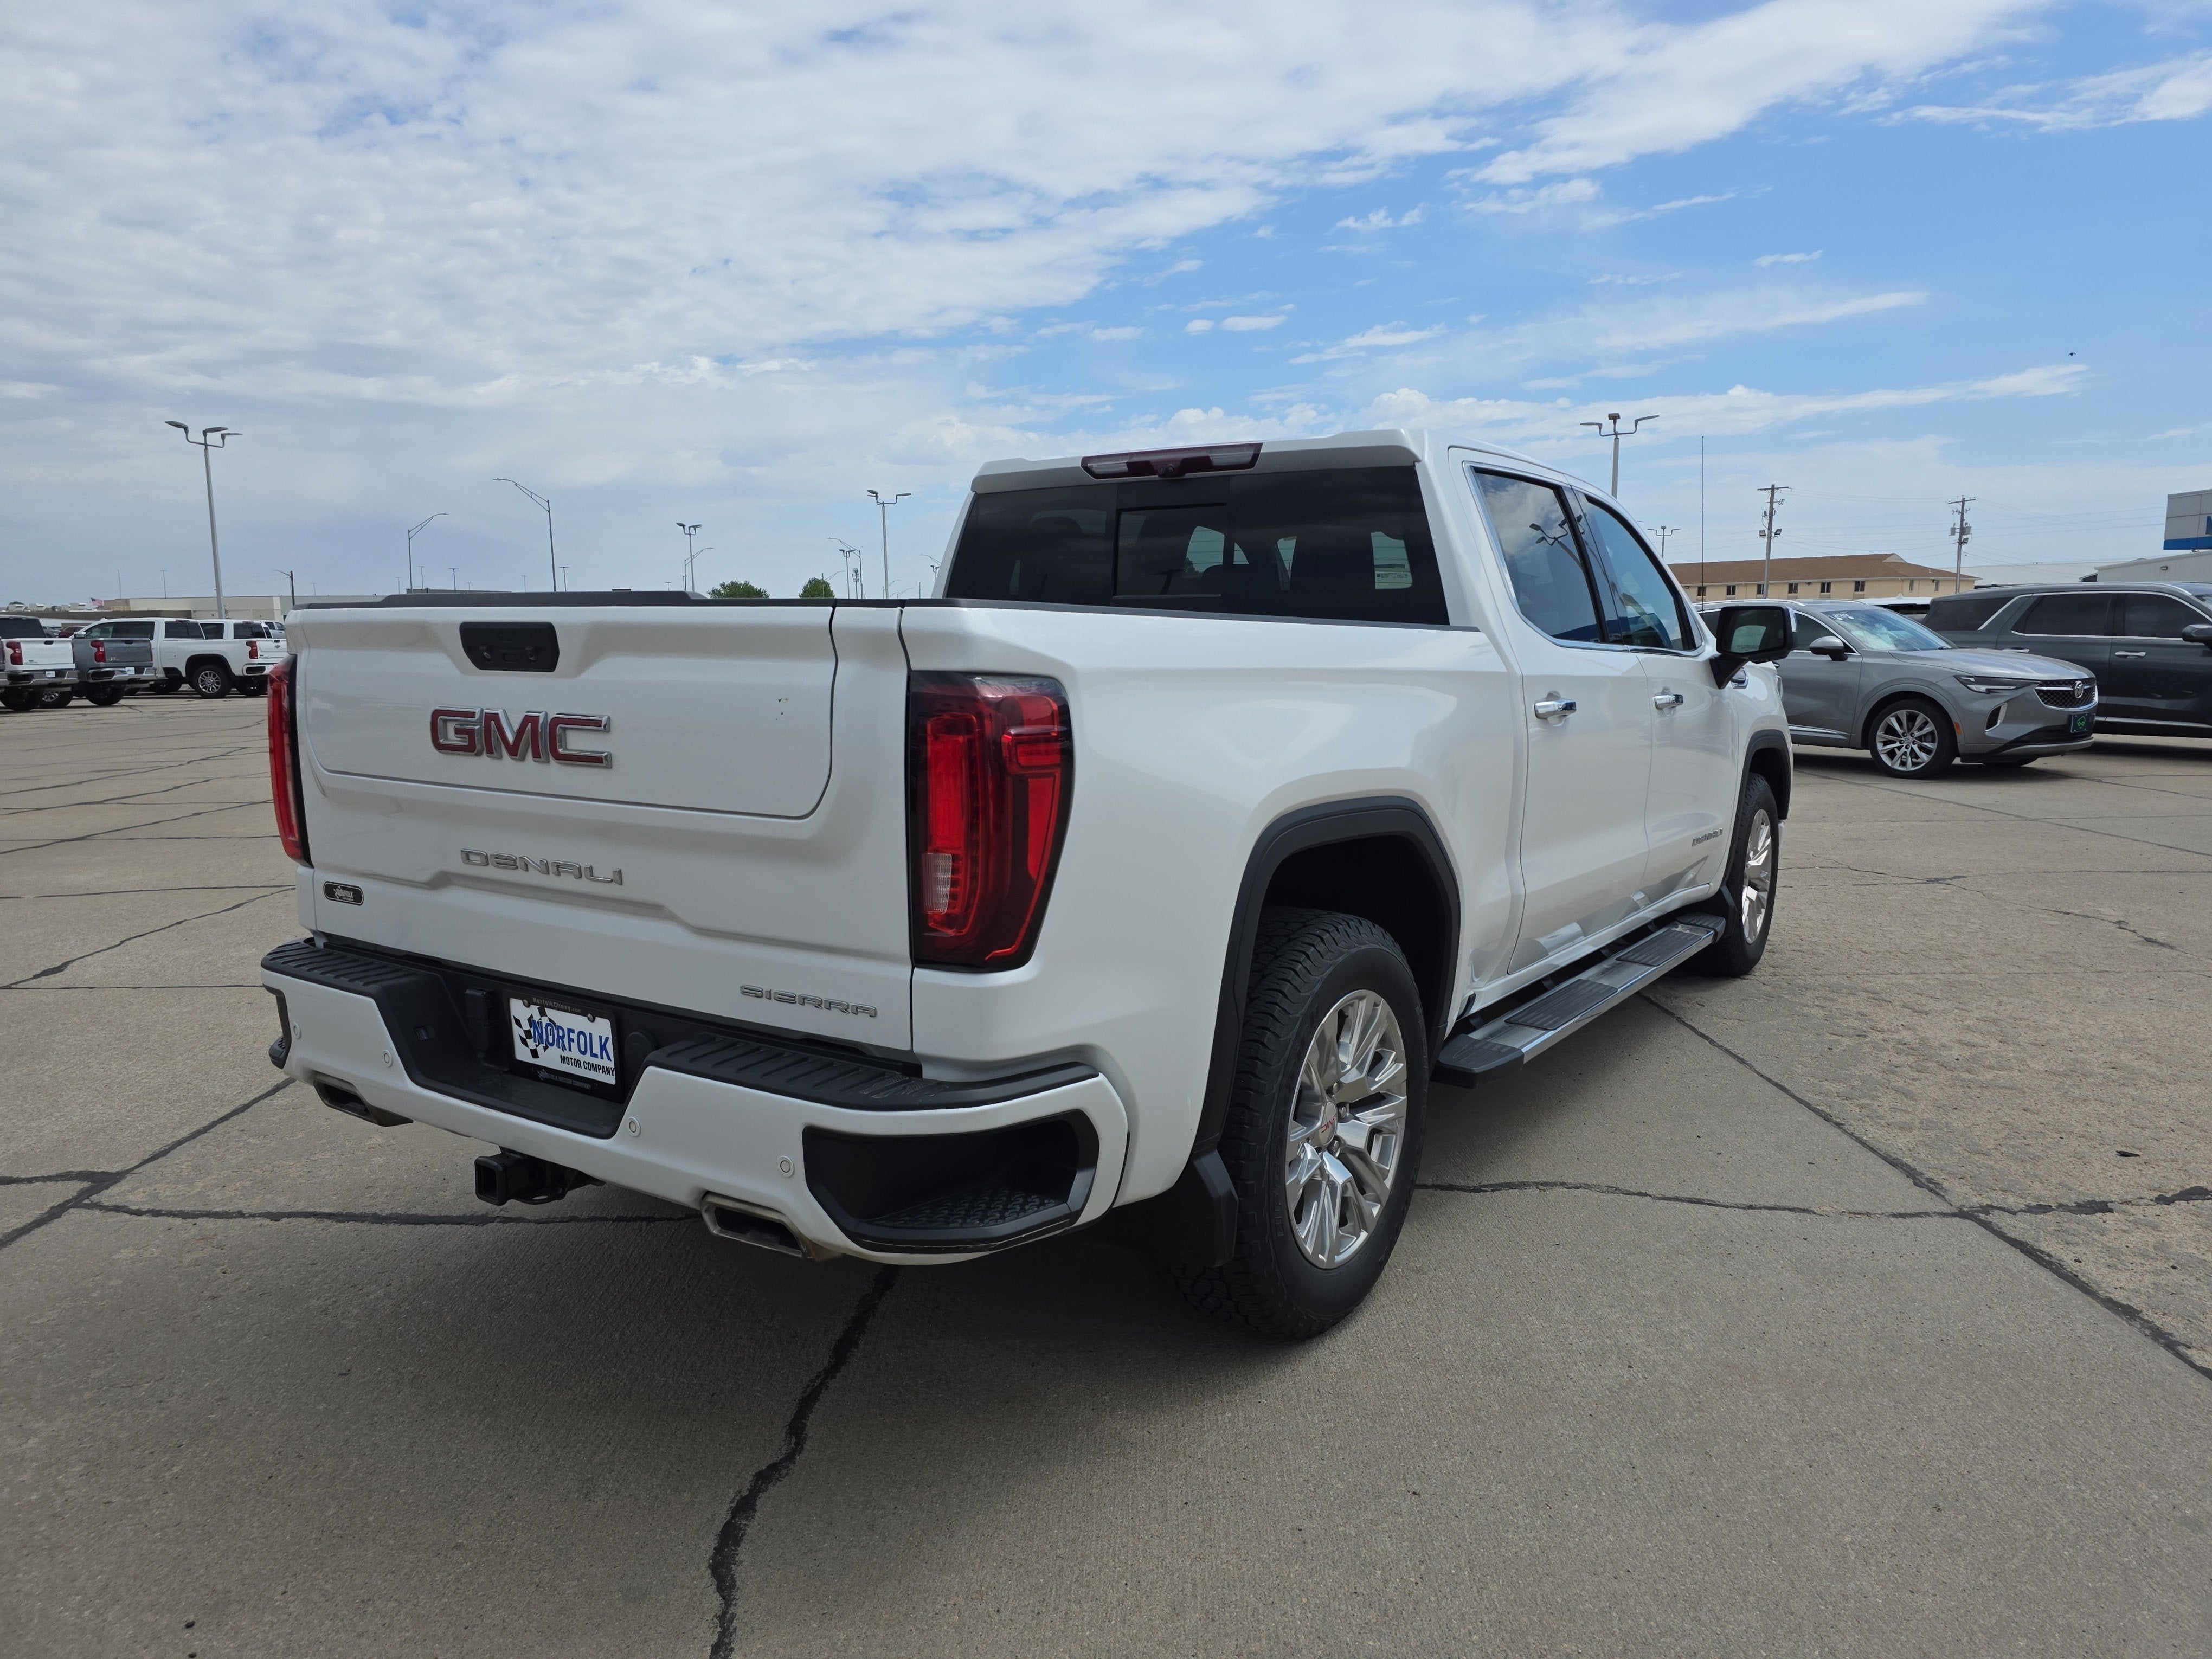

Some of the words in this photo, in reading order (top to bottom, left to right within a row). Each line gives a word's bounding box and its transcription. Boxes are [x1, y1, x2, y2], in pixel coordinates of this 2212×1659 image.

[430, 706, 612, 768] GMC
[460, 848, 622, 885] DENALI
[532, 997, 582, 1013] NorfolkChevy.com
[740, 984, 877, 1018] SIERRA
[532, 1019, 612, 1062] NORFOLK
[560, 1055, 582, 1069] MOTOR
[583, 1060, 615, 1077] COMPANY
[1321, 1114, 1337, 1134] GMC
